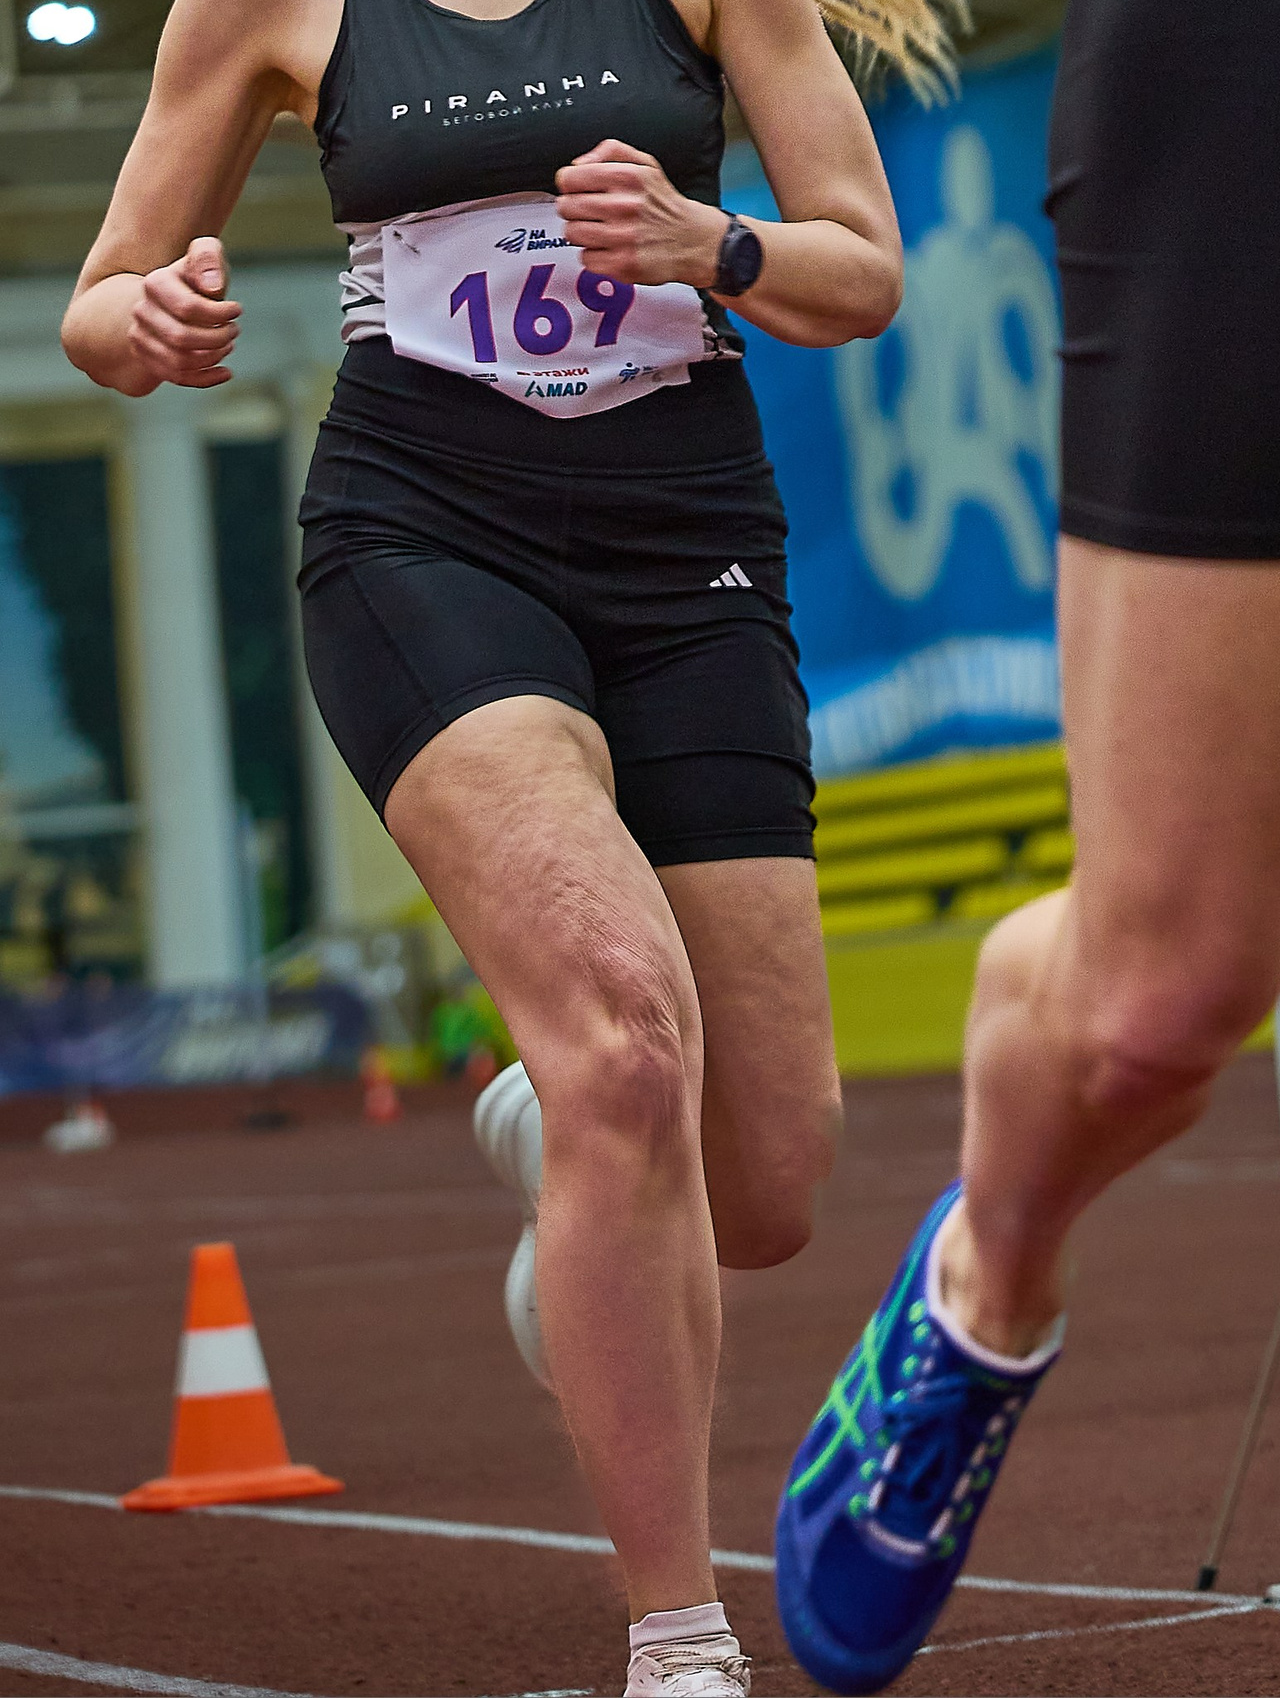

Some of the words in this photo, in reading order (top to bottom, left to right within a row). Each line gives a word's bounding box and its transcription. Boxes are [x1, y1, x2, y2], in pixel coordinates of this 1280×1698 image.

[391, 70, 620, 120] PIRANHA
[527, 237, 571, 251] ВИРАЖ
[529, 229, 546, 239] НА
[449, 263, 636, 363] 169
